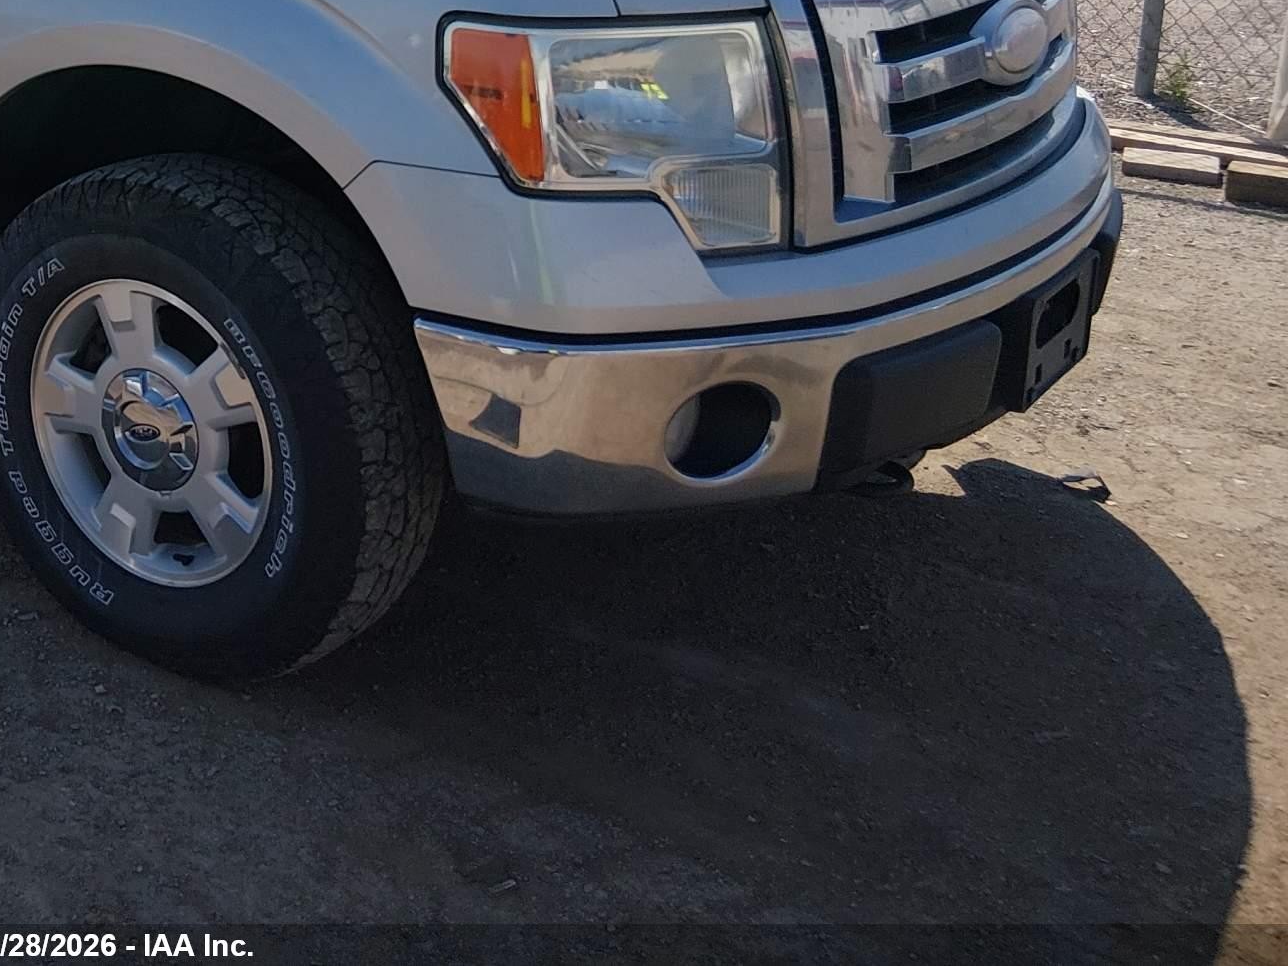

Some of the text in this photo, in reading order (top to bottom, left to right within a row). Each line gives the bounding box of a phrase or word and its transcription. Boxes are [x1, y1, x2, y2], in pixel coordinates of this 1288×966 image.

[21, 257, 66, 297] T/A
[223, 318, 296, 578] BFGoodrich
[8, 470, 115, 605] Rugged
